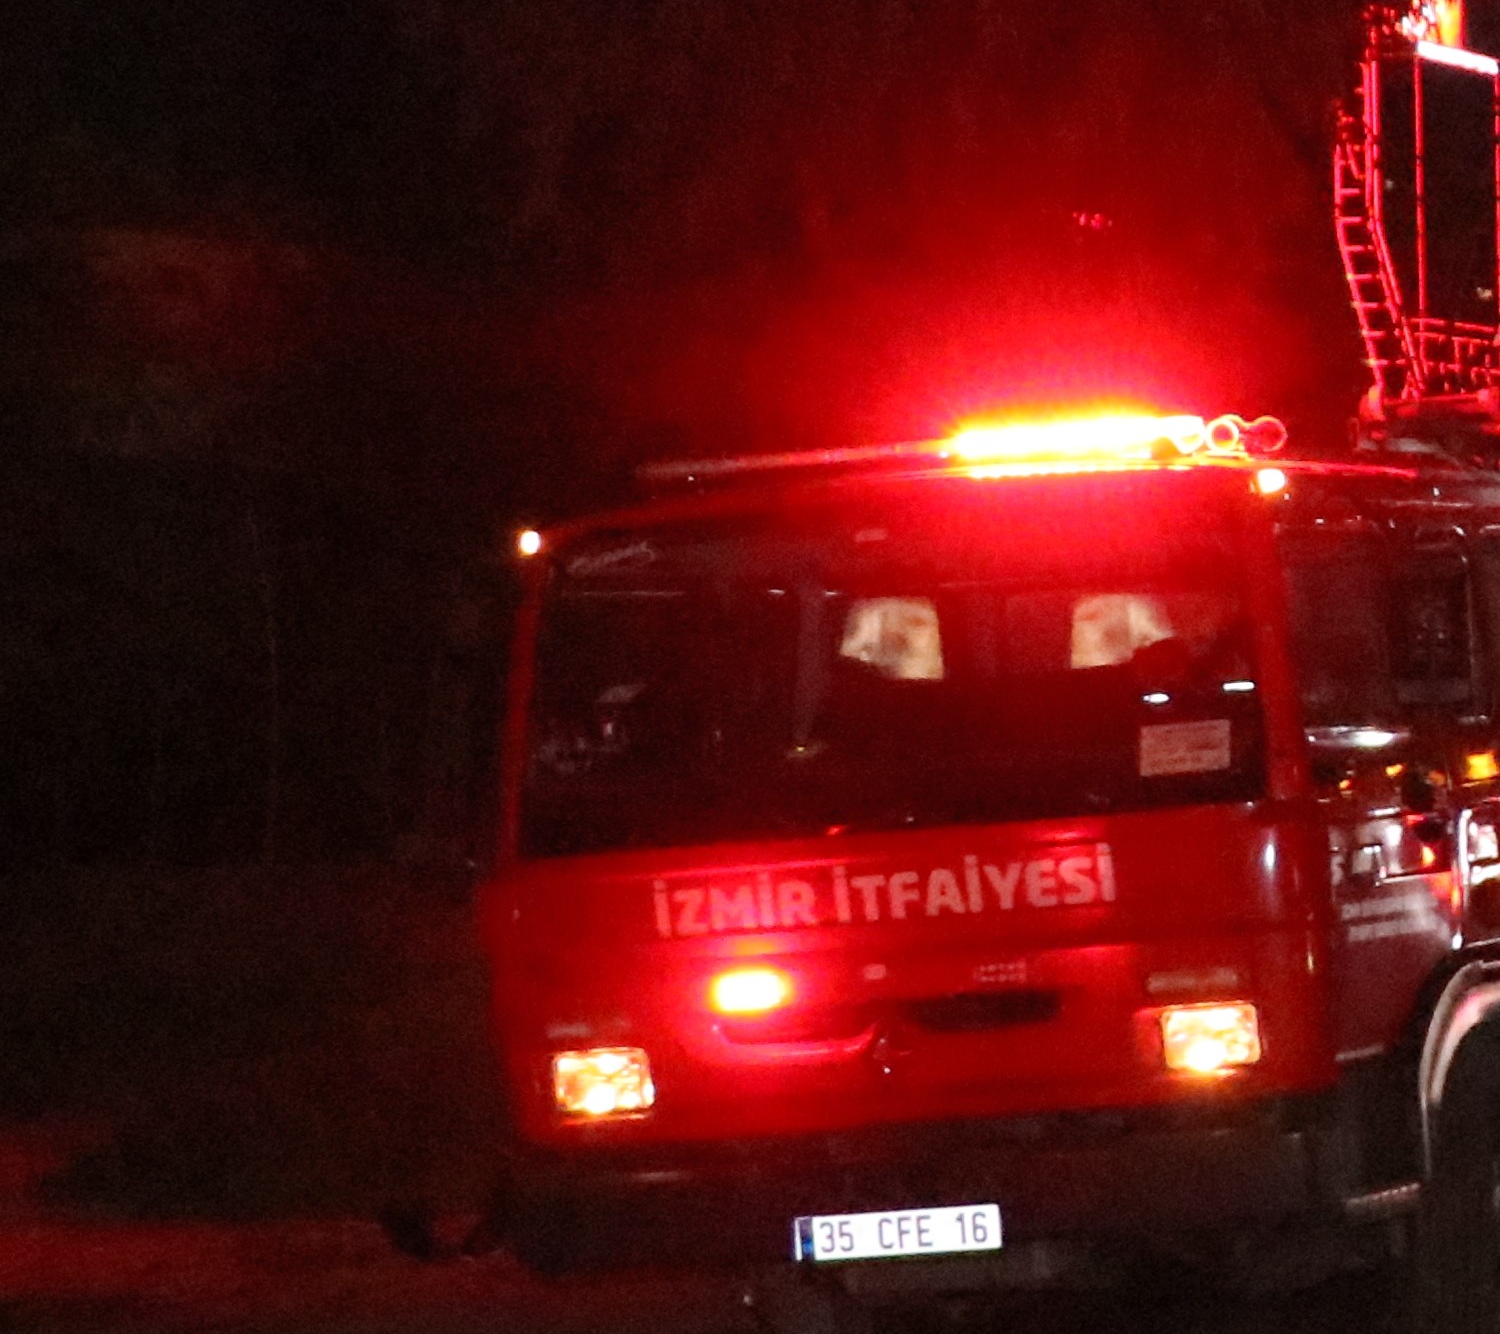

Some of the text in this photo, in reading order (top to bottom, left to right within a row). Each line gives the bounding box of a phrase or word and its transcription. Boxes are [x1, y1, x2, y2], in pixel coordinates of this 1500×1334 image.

[653, 842, 1117, 939] İZMİR İTFAİYESİ
[819, 1210, 988, 1254] 35 CFE 16
